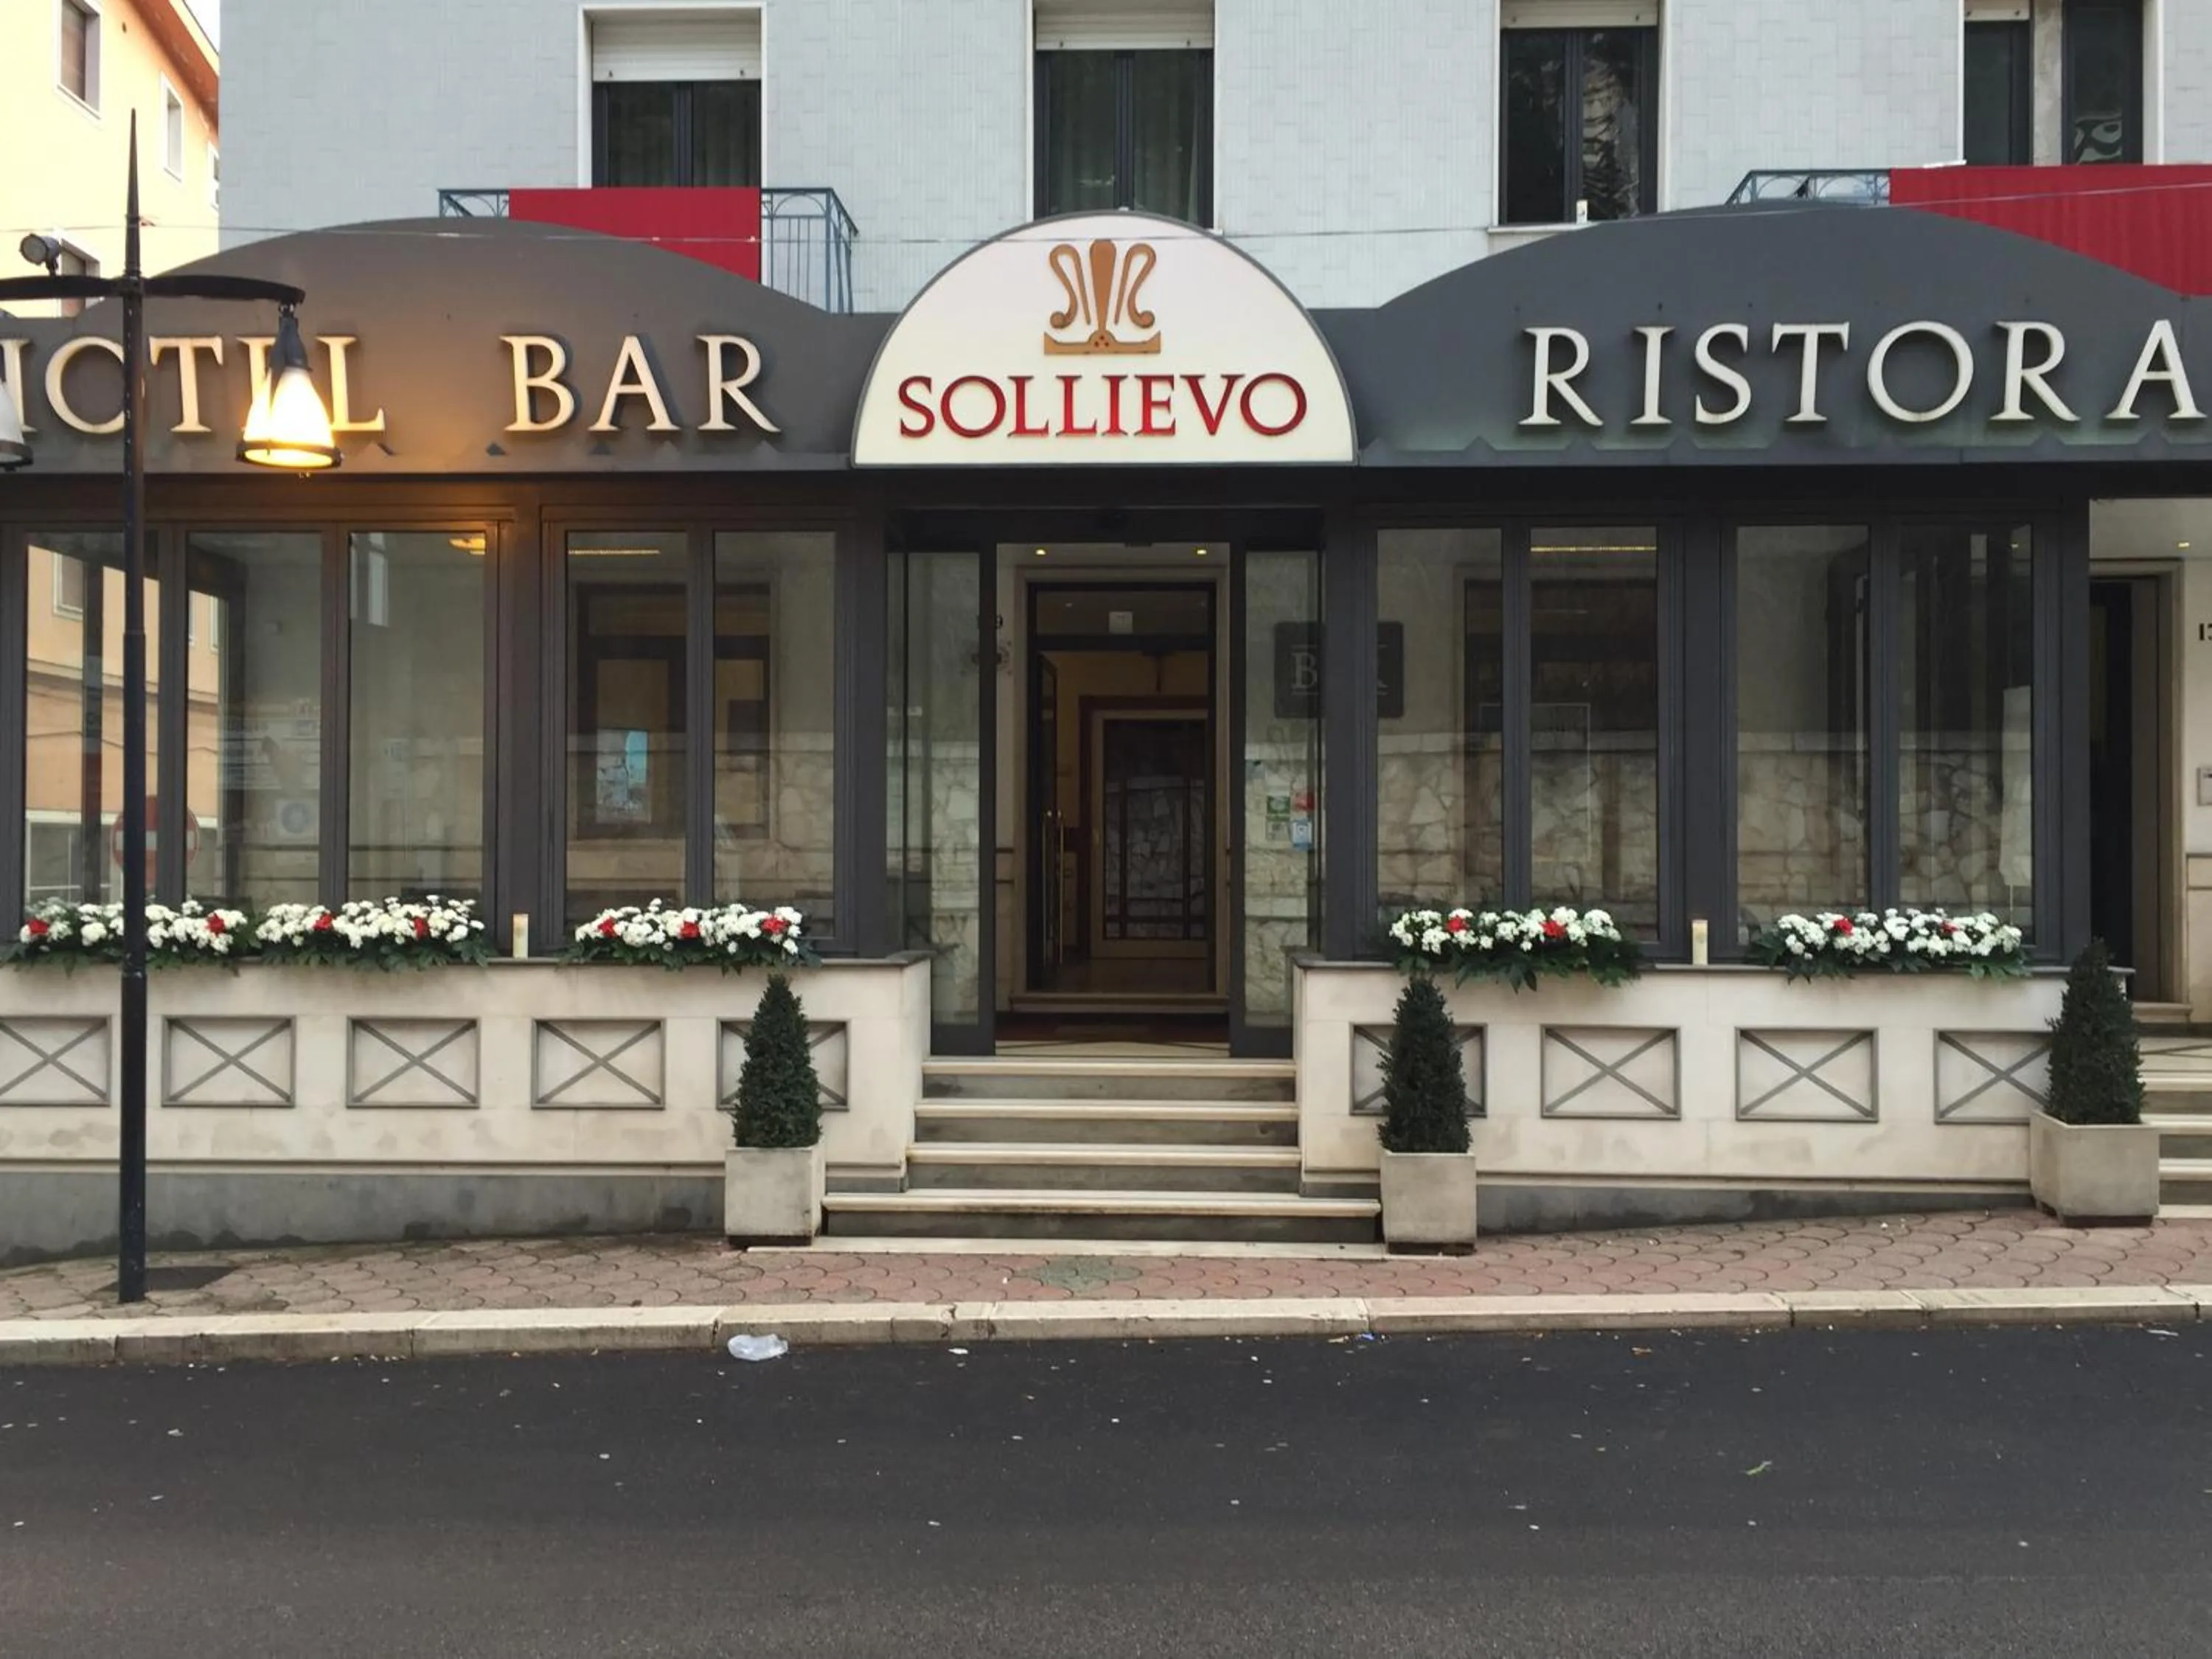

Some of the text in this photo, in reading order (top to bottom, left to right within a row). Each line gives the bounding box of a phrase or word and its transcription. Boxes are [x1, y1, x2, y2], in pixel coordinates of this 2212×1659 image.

[499, 335, 782, 433] BAR
[897, 372, 1307, 439] SOLLIEVO
[1518, 319, 2208, 426] RISTORA
